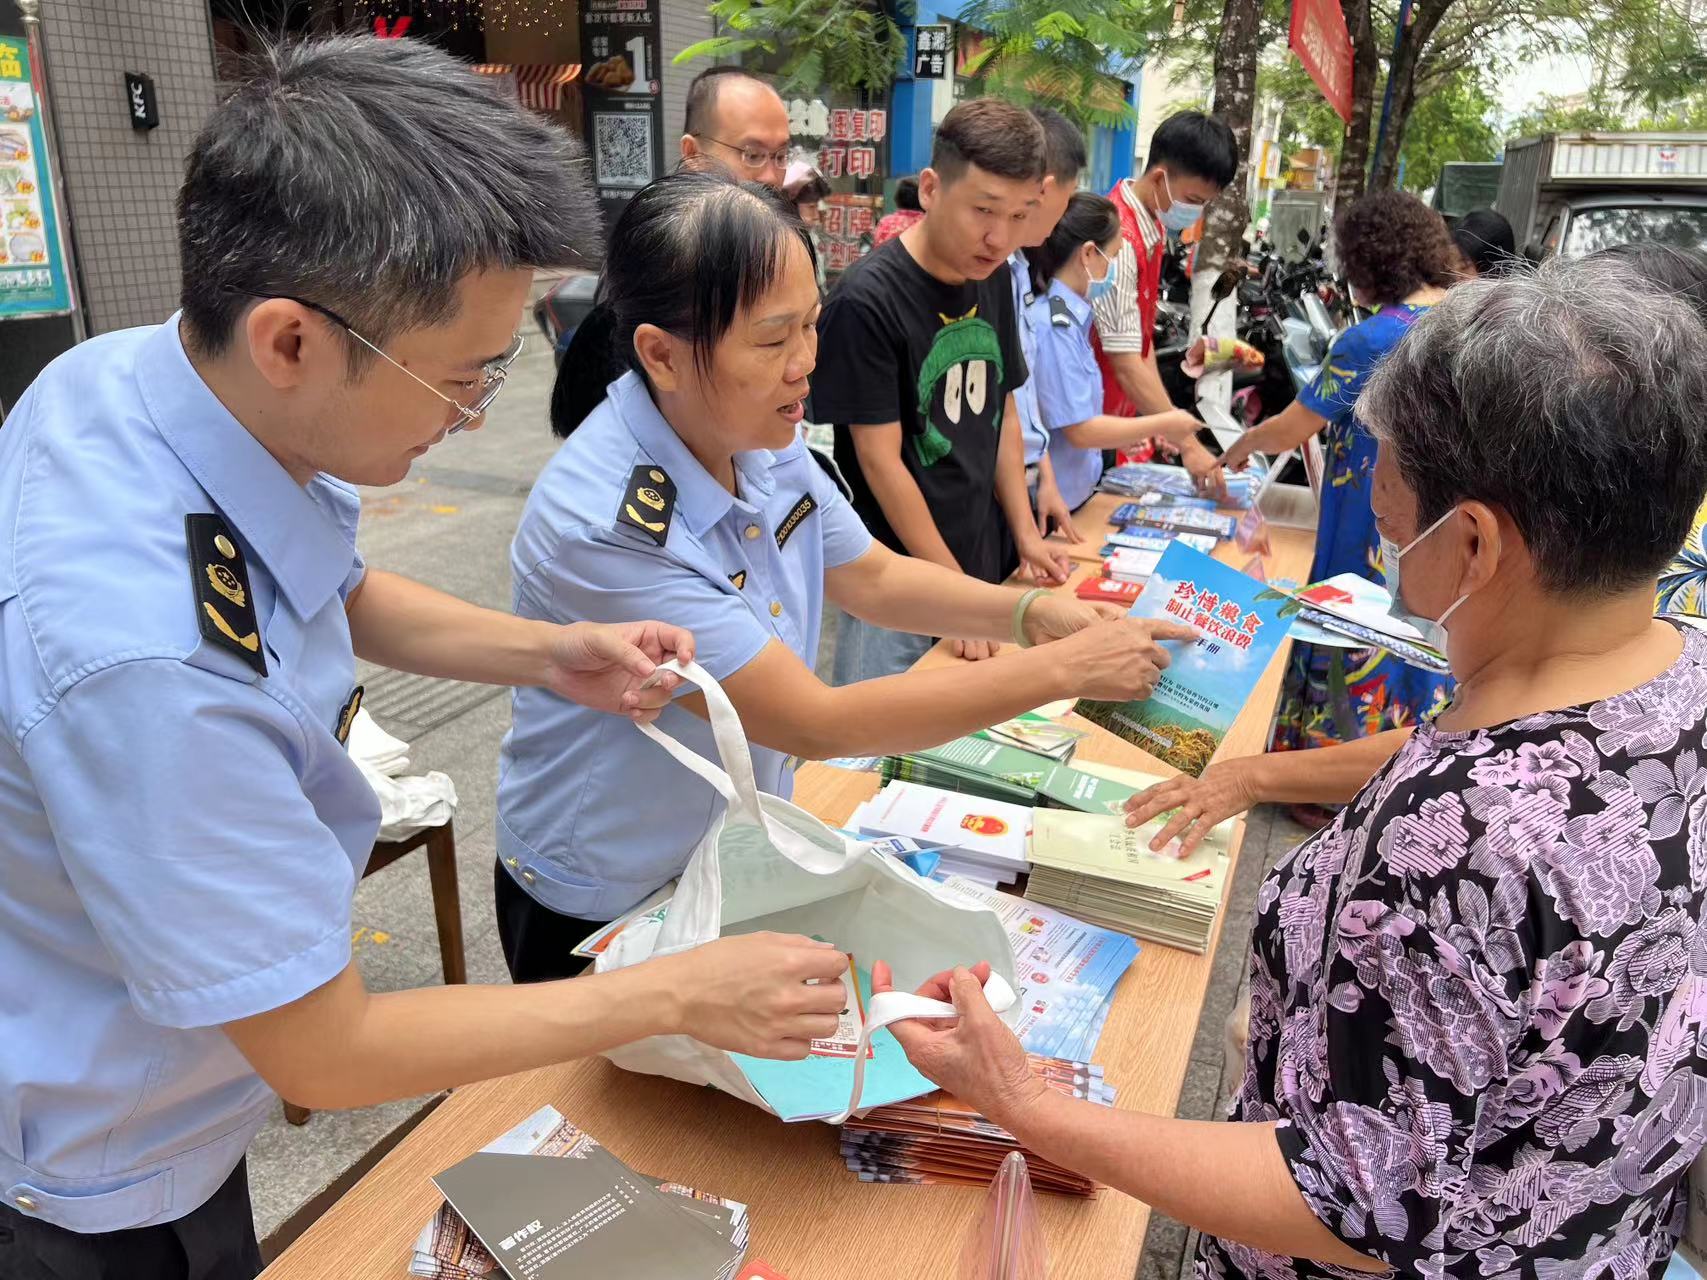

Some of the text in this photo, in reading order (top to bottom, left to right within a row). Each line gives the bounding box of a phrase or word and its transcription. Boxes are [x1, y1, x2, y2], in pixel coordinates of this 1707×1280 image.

[916, 54, 944, 74] 广告
[131, 84, 146, 118] KFC
[820, 147, 875, 179] 打印
[1165, 598, 1252, 650] 制止餐饮浪费
[1174, 582, 1262, 634] 珍惜粮食
[498, 1220, 543, 1251] 著作权
